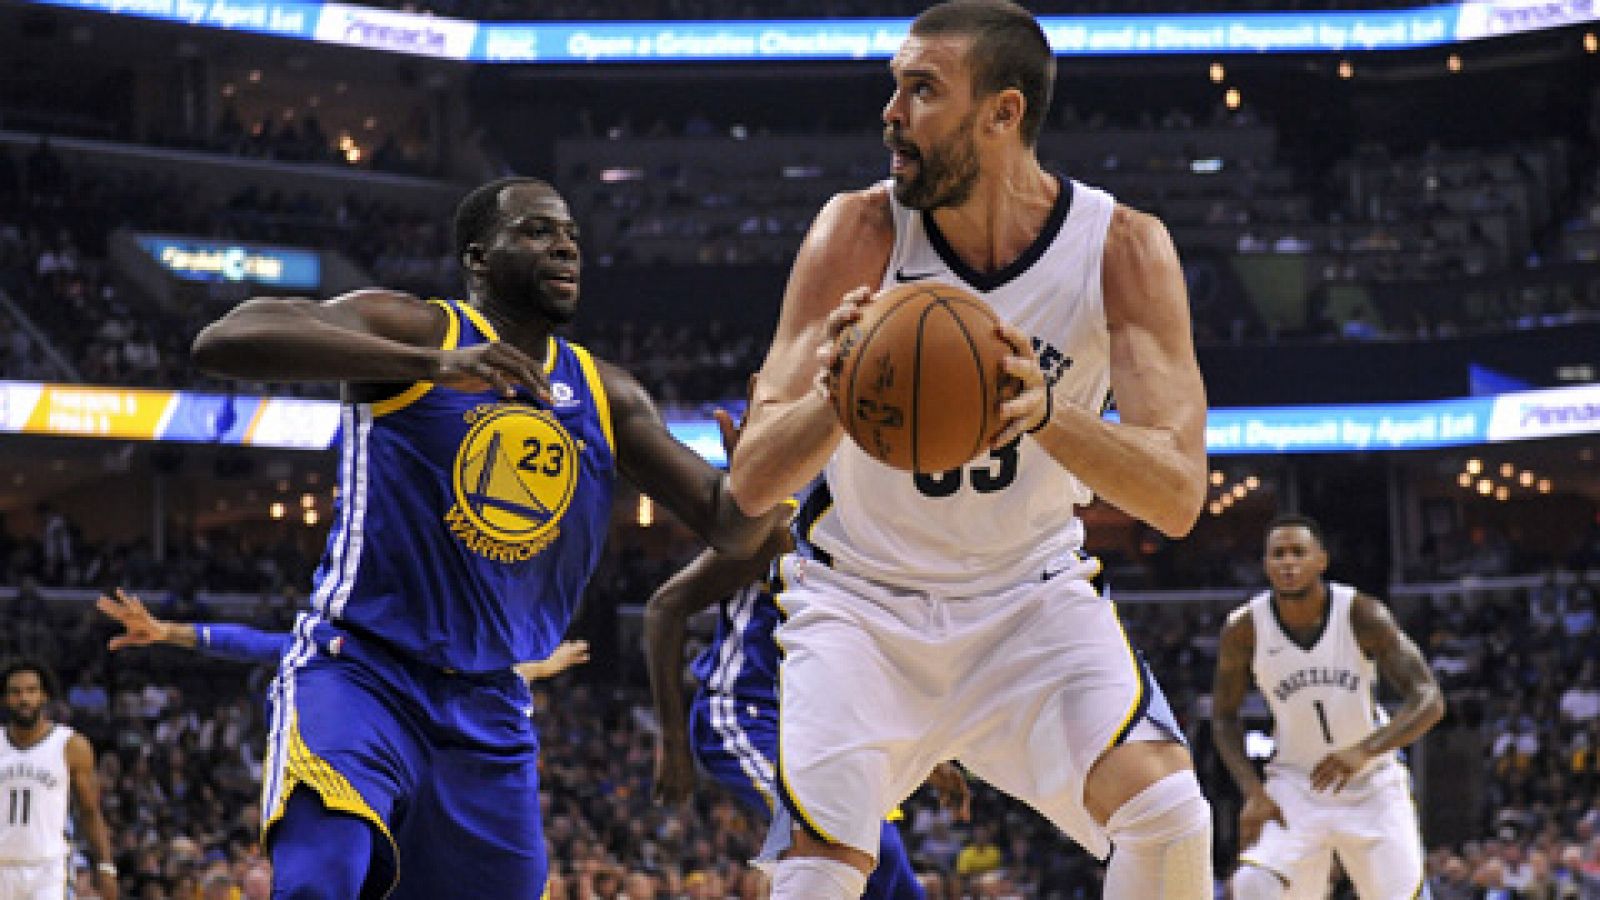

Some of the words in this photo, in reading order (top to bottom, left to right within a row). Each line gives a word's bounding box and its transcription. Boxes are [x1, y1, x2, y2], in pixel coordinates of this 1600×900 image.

[177, 0, 205, 24] by
[210, 0, 266, 29] April
[270, 7, 304, 33] 1st
[1088, 26, 1135, 49] and
[1155, 25, 1223, 48] Direct
[1229, 23, 1314, 52] Deposit
[1319, 23, 1348, 50] by
[1352, 21, 1407, 49] April
[1411, 17, 1444, 41] 1st
[567, 32, 634, 60] Open
[655, 30, 755, 56] Grizzlies
[759, 30, 868, 58] Checking
[1246, 419, 1338, 450] Deposit
[1342, 417, 1372, 449] by
[1376, 415, 1438, 447] April
[1440, 412, 1476, 439] 1st
[518, 437, 564, 477] 23
[443, 502, 561, 564] WARRIORS
[1273, 666, 1360, 702] GRIZZLIES
[1314, 700, 1332, 743] 1
[9, 787, 32, 827] 11
